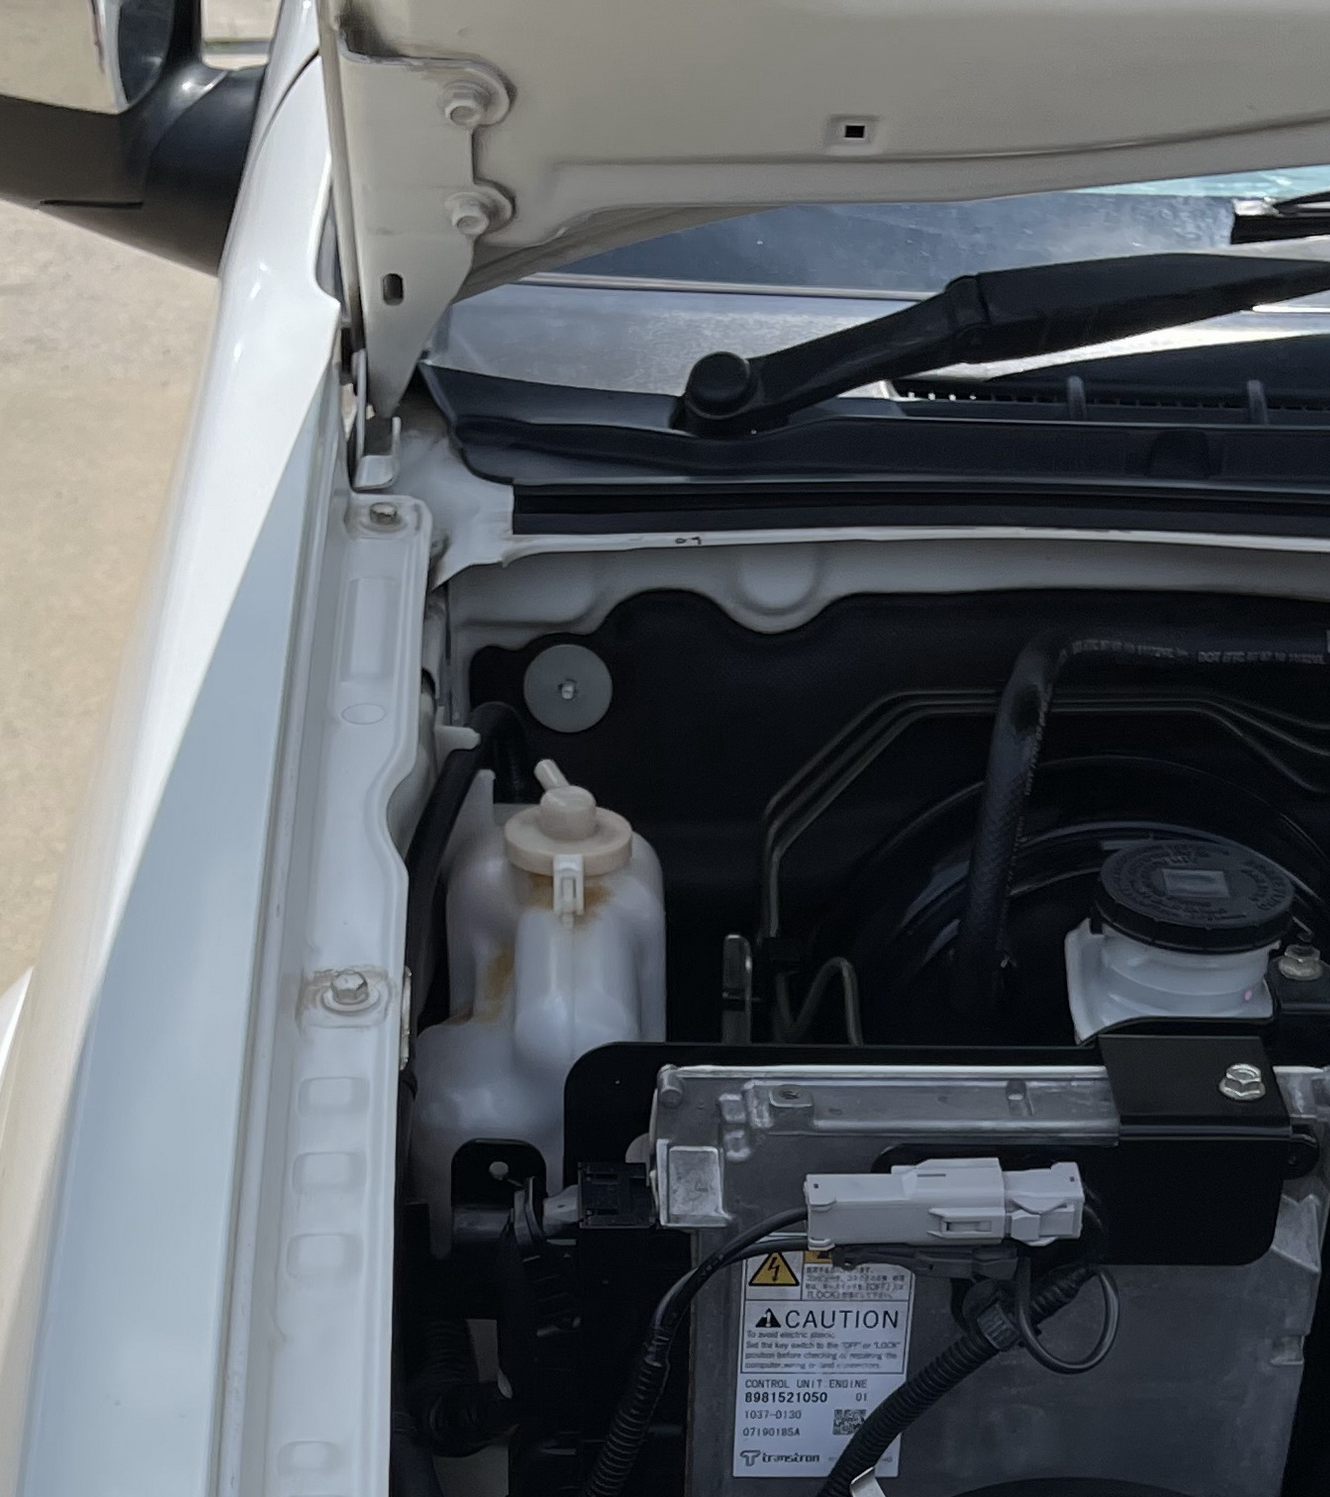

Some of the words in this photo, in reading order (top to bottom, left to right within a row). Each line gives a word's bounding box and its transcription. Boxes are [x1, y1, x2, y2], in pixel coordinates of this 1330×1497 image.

[785, 1309, 899, 1329] CAUTION
[744, 1379, 790, 1389] CONTROL
[796, 1379, 823, 1389] UNIT
[829, 1379, 868, 1389] ENGINE
[744, 1391, 828, 1403] 8981521050
[855, 1392, 868, 1402] 01
[762, 1451, 820, 1463] transtron
